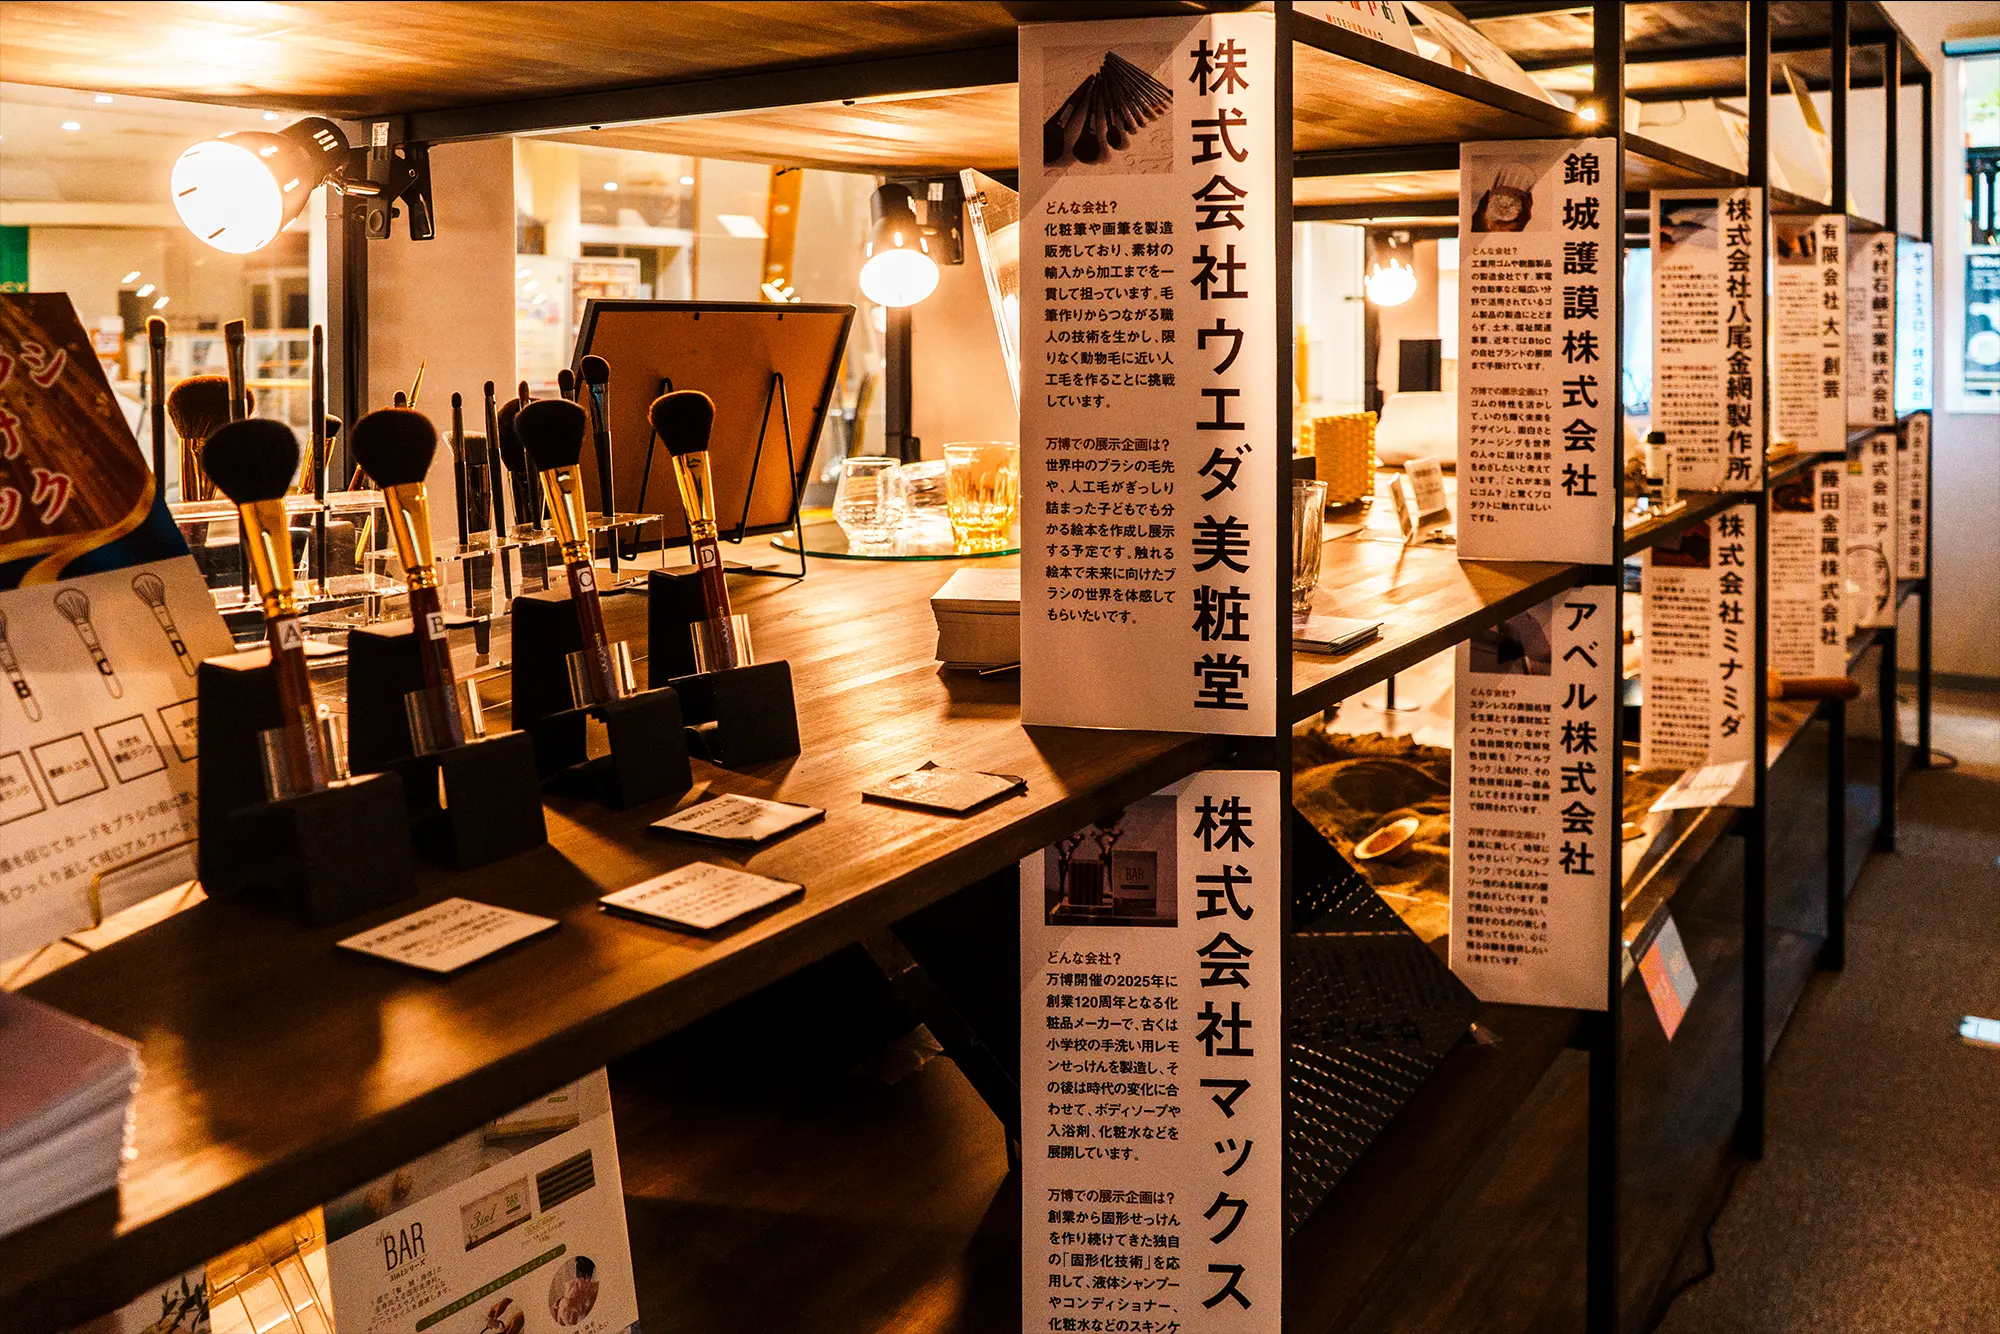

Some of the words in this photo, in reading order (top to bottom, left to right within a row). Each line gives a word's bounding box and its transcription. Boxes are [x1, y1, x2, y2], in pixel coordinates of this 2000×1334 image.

[1046, 201, 1117, 215] どんな会社?
[1044, 221, 1174, 236] 化粧筆や画筆を製造
[1044, 243, 1174, 258] 販売しており、素材の
[1044, 265, 1174, 280] 輸入から加工までを一
[1044, 286, 1174, 301] 貫して担っています。毛
[1044, 308, 1174, 322] 筆作りからつながる職
[1562, 153, 1600, 497] 錦城護謨株式会社
[1045, 329, 1175, 344] 人の技術を生かし、限
[1725, 197, 1753, 480] 株式会社八尾金網製作所
[1046, 351, 1174, 366] りなく動物毛に近い人
[1045, 372, 1175, 387] 工毛を作ることに挑戦
[1189, 38, 1251, 711] 株式会社ウエダ美粧堂
[1046, 394, 1112, 409] しています。
[1045, 438, 1170, 452] 万博での展示企画は?
[1045, 458, 1175, 473] 世界中のブラシの毛先
[1046, 479, 1175, 495] や、人工毛がぎっしり
[1045, 501, 1175, 517] 詰まった子どもでも分
[1046, 523, 1176, 538] かる絵本を作成し展示
[702, 549, 715, 564] D
[1047, 544, 1175, 560] する予定です。触れる
[580, 572, 593, 587] C
[1045, 565, 1177, 581] 絵本で未来に向けたブ
[1047, 587, 1177, 603] ラシの世界を体感して
[1047, 608, 1137, 624] もらいたいです。
[431, 617, 445, 634] B
[1717, 513, 1745, 738] 株式会社ミナミダ
[284, 624, 301, 644] A
[172, 639, 187, 657] D
[14, 679, 30, 698] B
[1560, 602, 1598, 876] アベル株式会社
[1047, 951, 1120, 965] どんな会社?
[1046, 972, 1178, 987] 万博開催の2025年に
[1046, 995, 1178, 1009] 創業120周年となる化
[1046, 1017, 1178, 1032] 粧品メーカーで、古くは
[1046, 1038, 1180, 1053] 小学校の手洗い用レモ
[1193, 795, 1255, 1310] 株式会社マックス
[1047, 1060, 1178, 1075] ンせっけんを製造し、そ
[1047, 1082, 1179, 1096] の後は時代の変化に合
[1047, 1103, 1181, 1117] わせて、ボディソープや
[1047, 1124, 1179, 1139] 入浴剤、化粧水などを
[1047, 1146, 1140, 1161] 展開しています。
[1048, 1188, 1175, 1204] 万博での展示企画は?
[1048, 1210, 1180, 1226] 創業から固形せっけん
[384, 1222, 425, 1271] BAR
[1049, 1231, 1180, 1248] を作り続けてきた独自
[1049, 1252, 1180, 1270] の「固形化技術」を応
[1049, 1274, 1180, 1290] 用して、液体シャンプー
[1049, 1296, 1180, 1313] やコンディショナー、
[1049, 1317, 1180, 1334] 化粧水などのスキンケ
